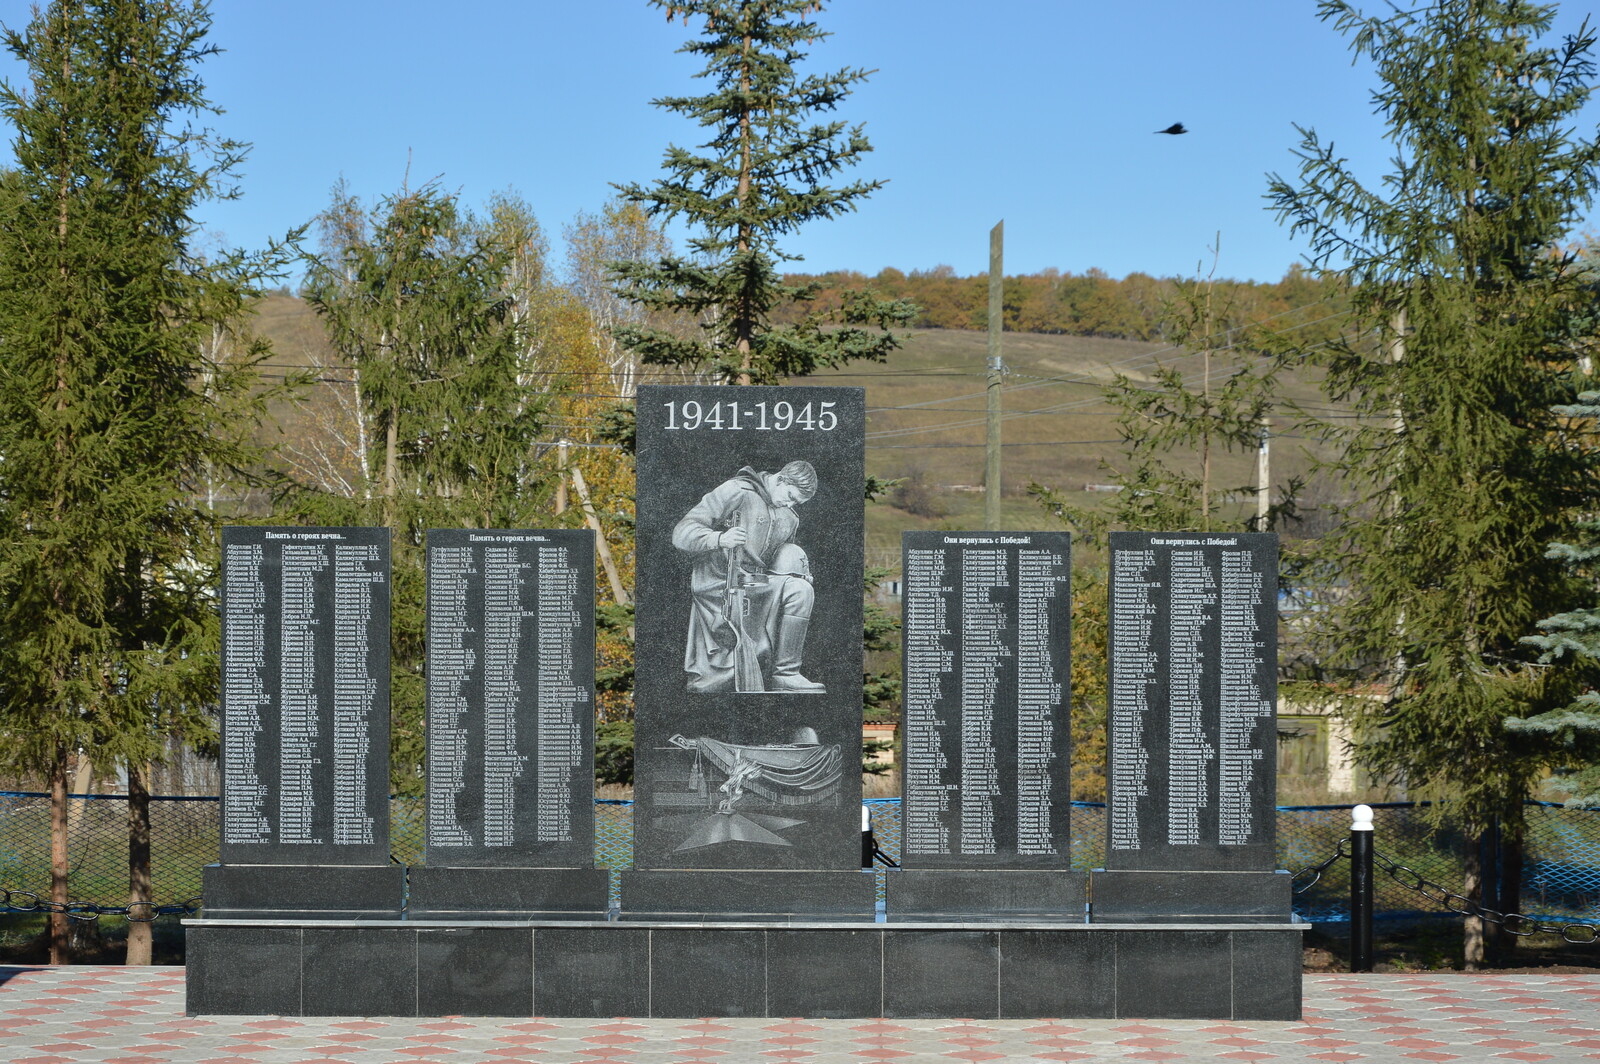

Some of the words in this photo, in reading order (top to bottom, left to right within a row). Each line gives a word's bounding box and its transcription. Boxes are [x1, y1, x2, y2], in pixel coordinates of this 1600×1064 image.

[663, 401, 839, 431] 1941-1945
[265, 532, 291, 540] Память
[298, 533, 321, 541] героях
[469, 534, 496, 542] Память
[502, 535, 525, 543] героях
[959, 537, 994, 545] вернулись
[1000, 535, 1031, 545] Победой!
[1165, 539, 1201, 547] вернулись
[1206, 537, 1238, 547] Победой!
